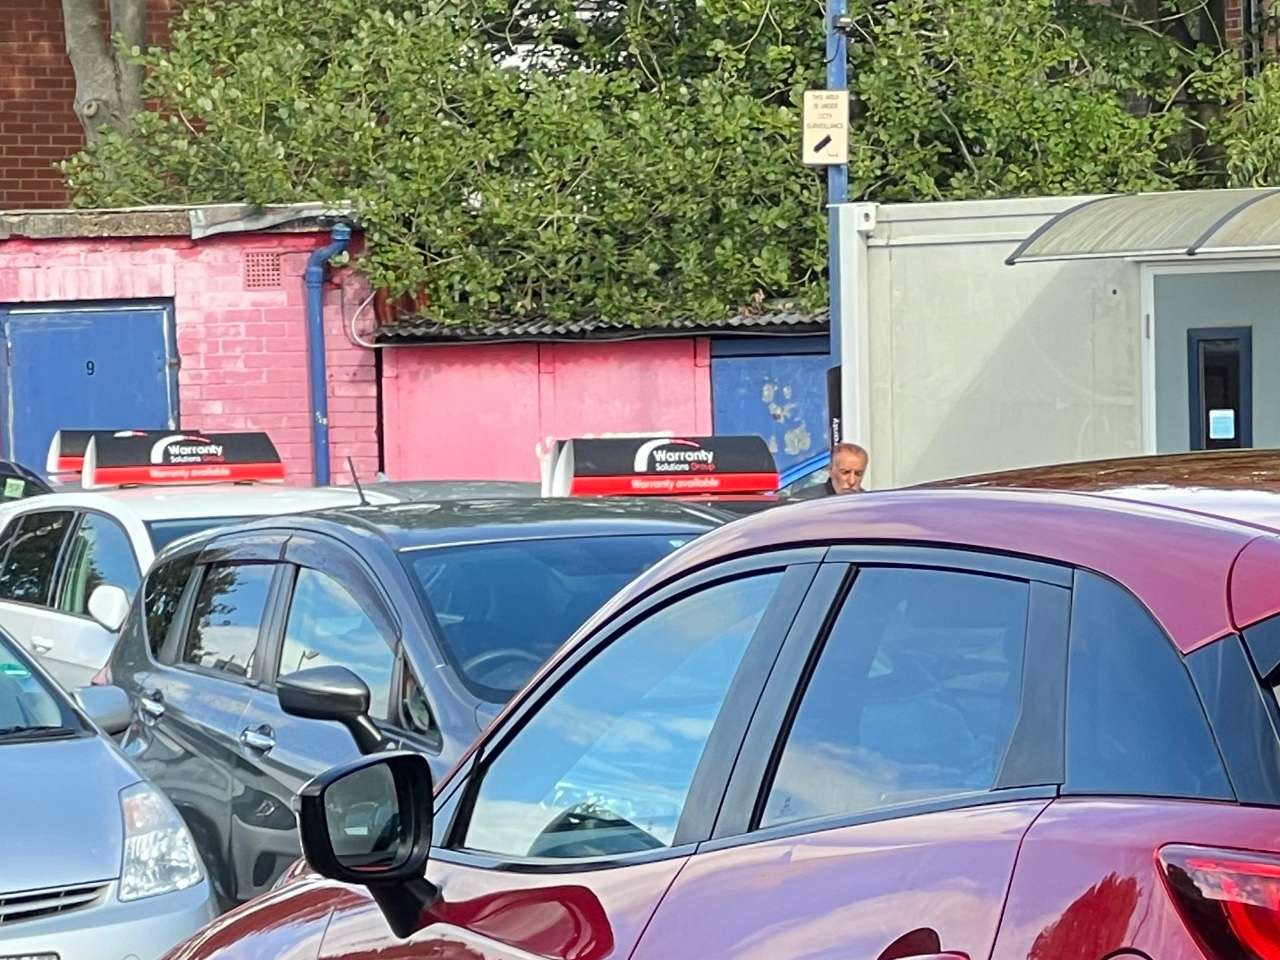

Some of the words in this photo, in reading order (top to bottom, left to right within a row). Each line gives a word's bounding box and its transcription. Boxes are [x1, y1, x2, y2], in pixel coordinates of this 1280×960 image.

[86, 360, 95, 376] 9
[832, 418, 840, 446] ranty
[167, 444, 222, 456] Warranty
[170, 455, 202, 463] Solutions
[653, 450, 714, 463] Warranty
[655, 462, 690, 471] Solutions
[691, 463, 716, 472] Group
[150, 469, 189, 478] Warranty
[631, 479, 674, 489] Warranty
[676, 478, 718, 487] available
